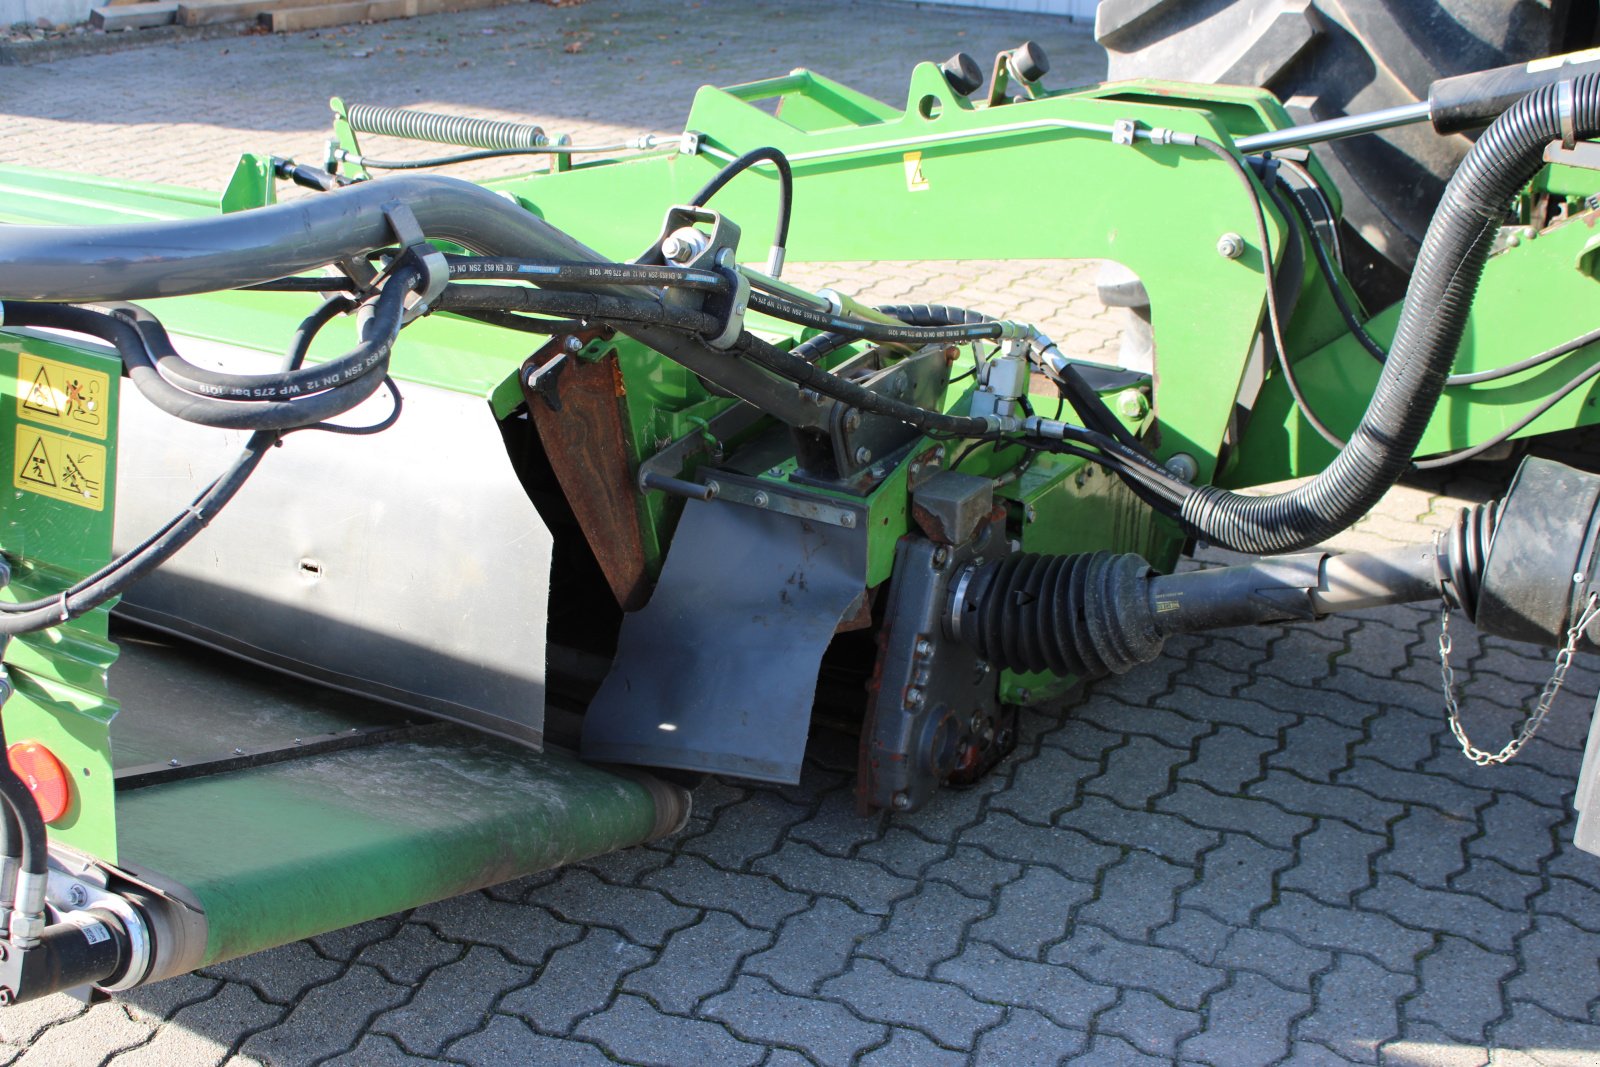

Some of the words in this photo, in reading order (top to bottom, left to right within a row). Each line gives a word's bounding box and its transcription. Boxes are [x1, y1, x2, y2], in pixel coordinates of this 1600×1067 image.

[344, 363, 363, 378] 2SN
[323, 373, 340, 385] DN
[280, 384, 300, 395] WP
[307, 380, 320, 389] 12
[230, 388, 250, 397] bar
[254, 387, 276, 397] 275
